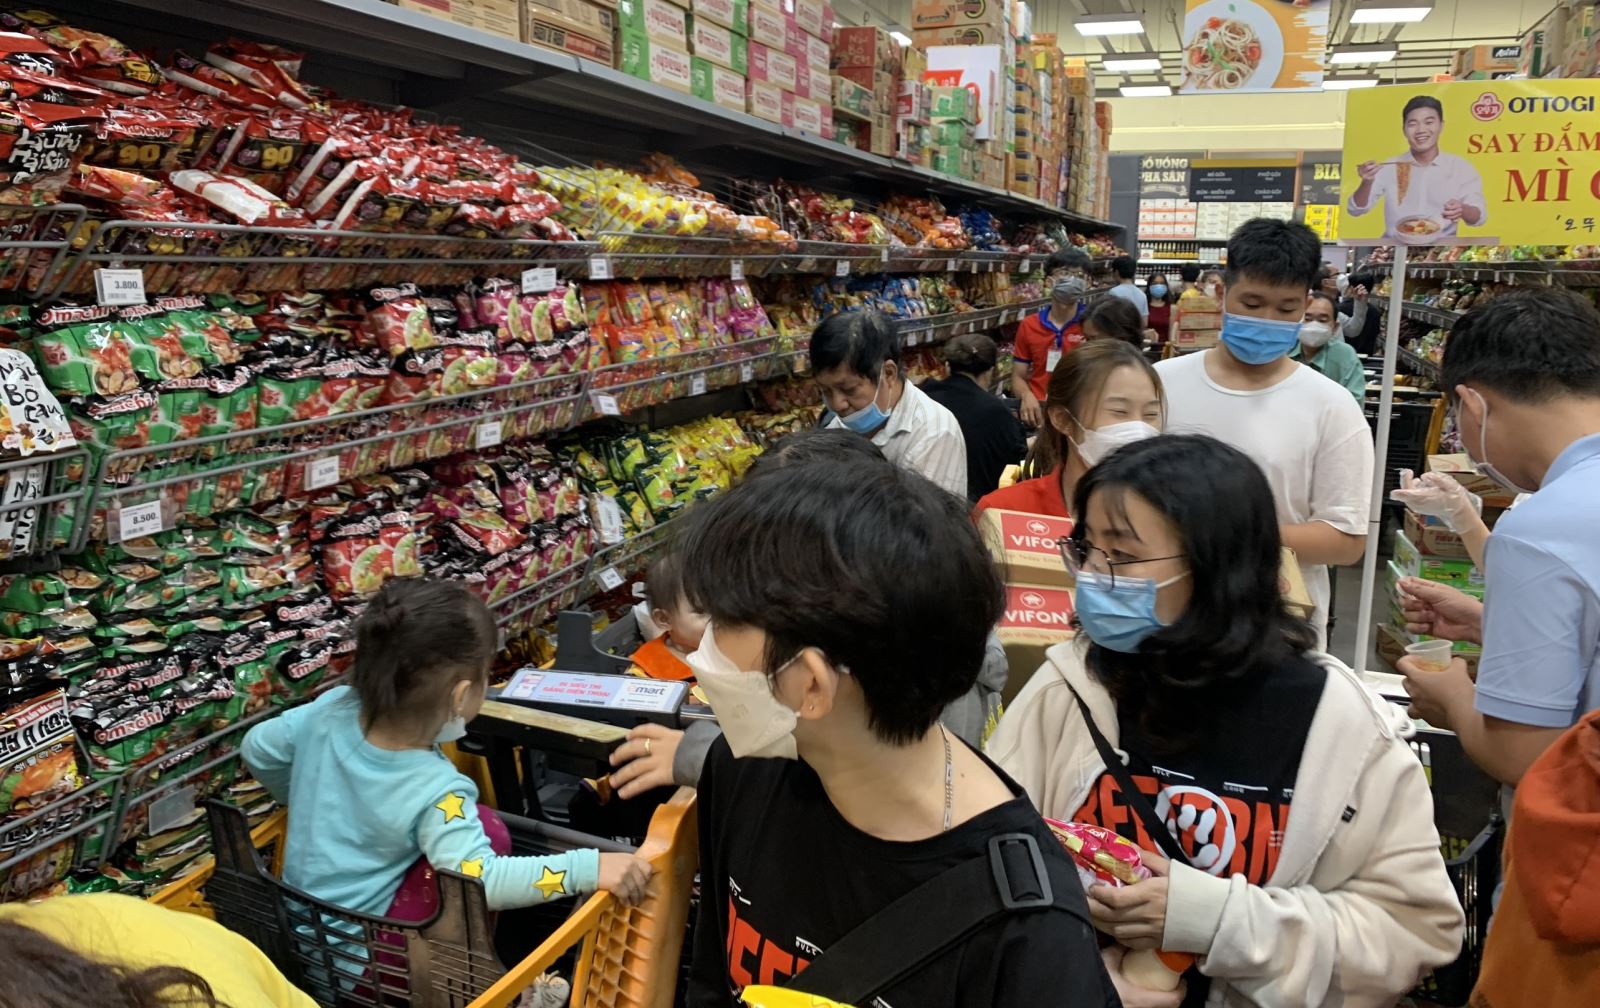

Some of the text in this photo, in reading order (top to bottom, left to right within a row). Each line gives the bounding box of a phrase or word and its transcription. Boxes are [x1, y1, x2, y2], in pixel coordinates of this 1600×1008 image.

[1508, 96, 1595, 113] OTTOGI
[1467, 133, 1526, 154] SAY
[119, 144, 161, 165] 90
[262, 146, 294, 168] 90
[1314, 164, 1340, 180] BIA
[1502, 157, 1574, 202] MÌ
[115, 280, 138, 289] 3.800
[132, 512, 156, 525] 8.500
[1005, 610, 1068, 624] VIFON
